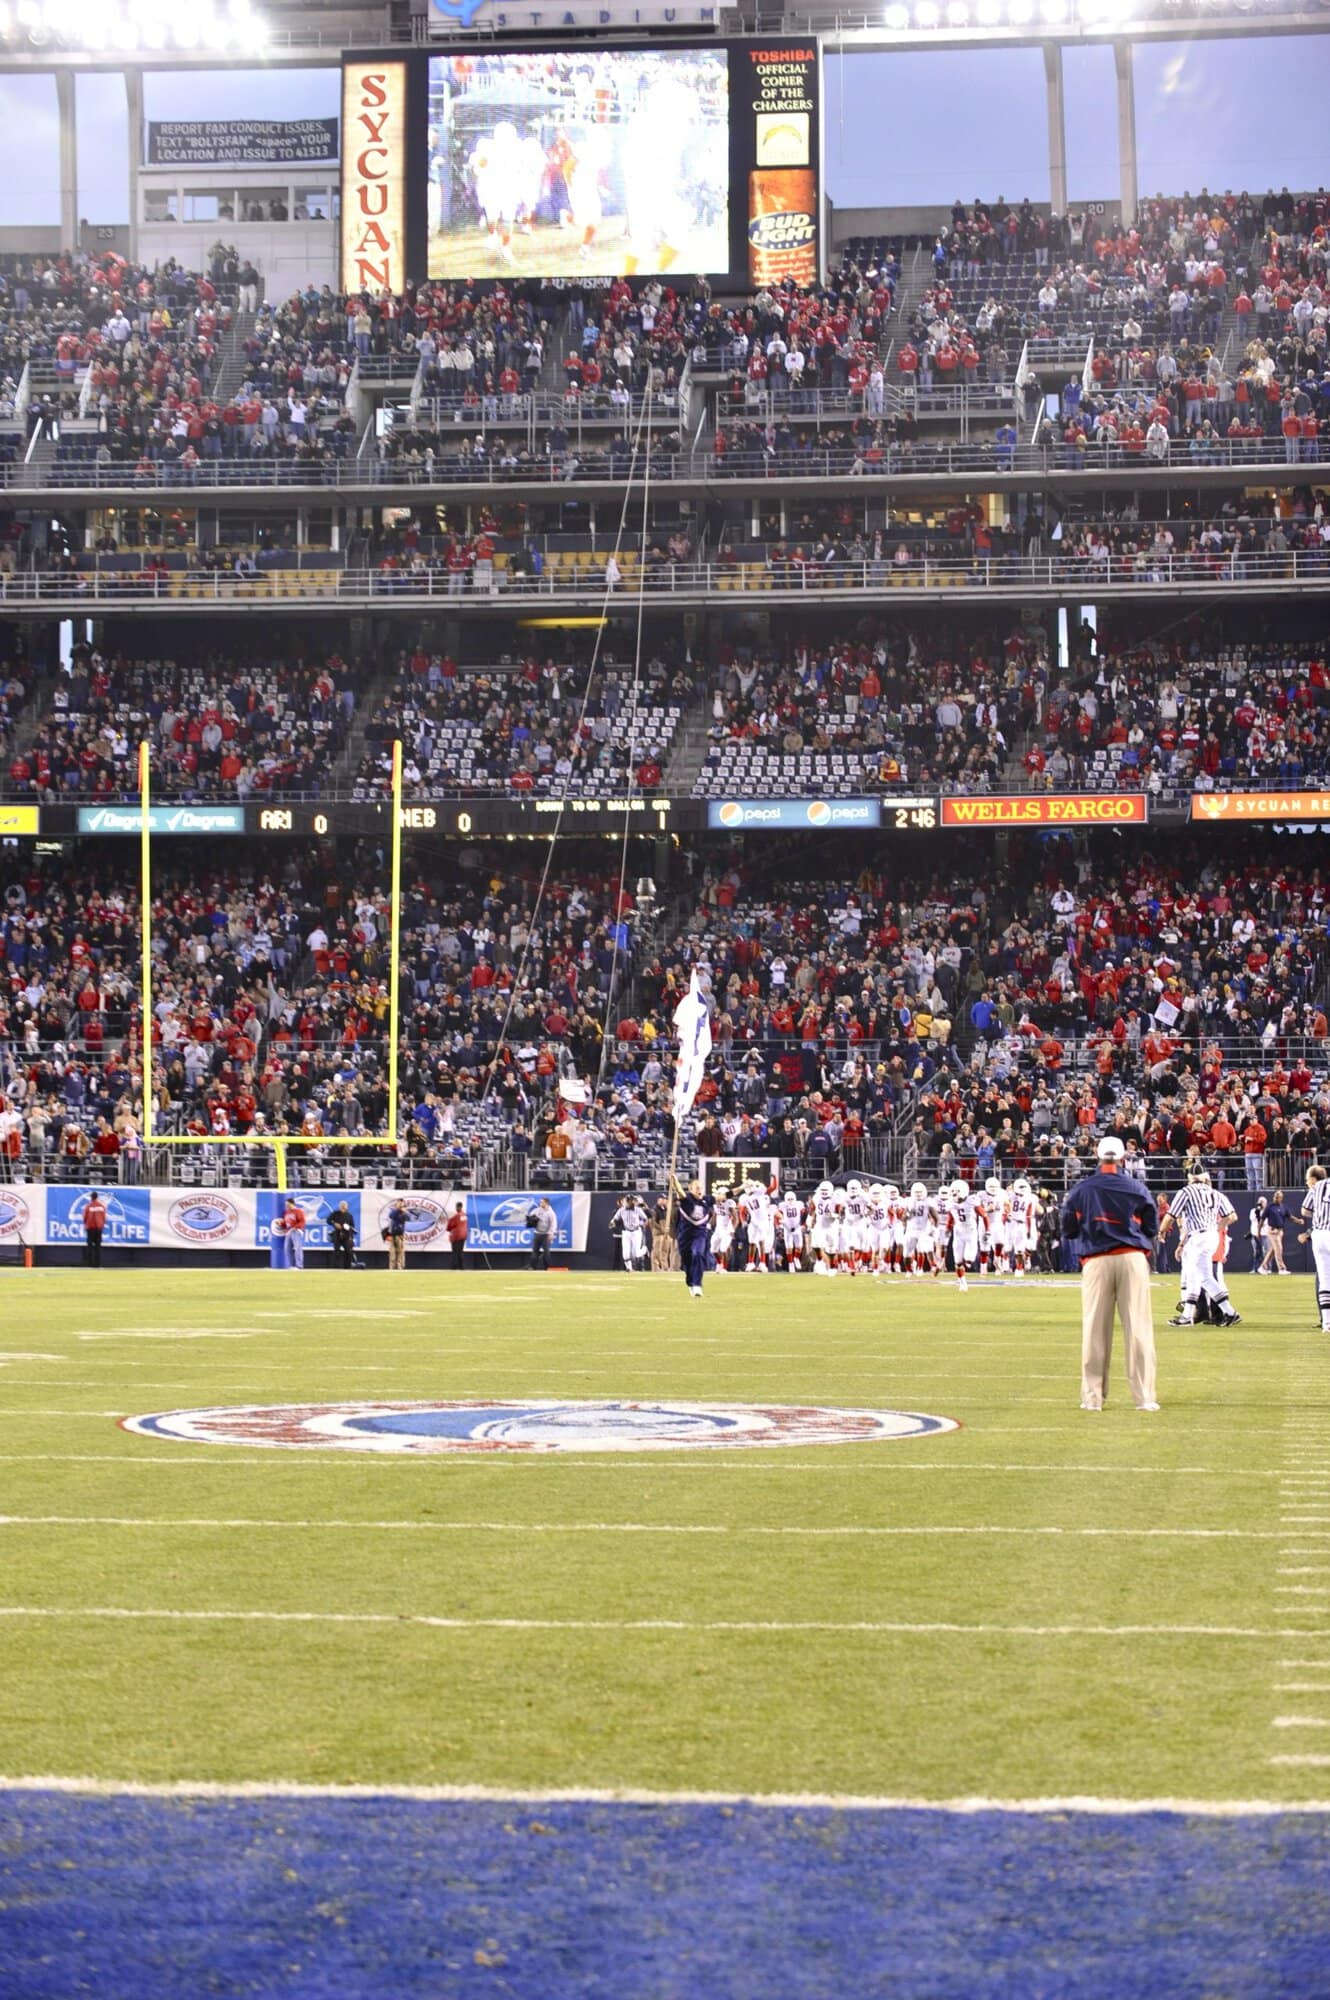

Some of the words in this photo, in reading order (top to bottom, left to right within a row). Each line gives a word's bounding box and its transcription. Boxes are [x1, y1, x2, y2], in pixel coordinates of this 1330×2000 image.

[498, 8, 714, 26] STADIUM
[750, 49, 815, 62] TOSHIBA
[756, 63, 808, 75] OFFICIAL
[761, 76, 804, 87] COPIER
[761, 88, 777, 99] OF
[780, 87, 804, 98] THE
[752, 99, 814, 111] CHARGERS
[161, 123, 202, 135] REPORT
[205, 123, 228, 134] FAN
[230, 122, 281, 133] CONDUCT
[156, 136, 183, 147] TEXT
[299, 133, 331, 145] YOUR
[157, 149, 215, 160] LOCATION
[217, 148, 241, 159] AND
[243, 148, 277, 159] ISSUE
[279, 148, 294, 158] TO
[354, 74, 390, 289] SYCUAN
[760, 214, 810, 231] BUD
[752, 225, 816, 243] LIGHT
[744, 807, 781, 821] pepsi
[832, 806, 869, 820] pepsi
[952, 800, 1042, 821] WELLS
[1048, 799, 1135, 818] FARGO
[1235, 799, 1302, 812] SYCUAN
[103, 813, 156, 831] Degre
[182, 812, 236, 831] Degree
[260, 810, 292, 830] ARI
[314, 815, 328, 834] 0
[458, 813, 472, 832] 0
[179, 1197, 211, 1210] PACIFIC
[212, 1197, 229, 1212] LIFE
[1012, 1200, 1026, 1213] 84
[49, 1221, 111, 1240] PACIC
[112, 1221, 146, 1240] LIFE
[174, 1221, 208, 1240] HOLIDAY
[209, 1224, 232, 1240] BOWL
[470, 1227, 531, 1244] PACIFIC
